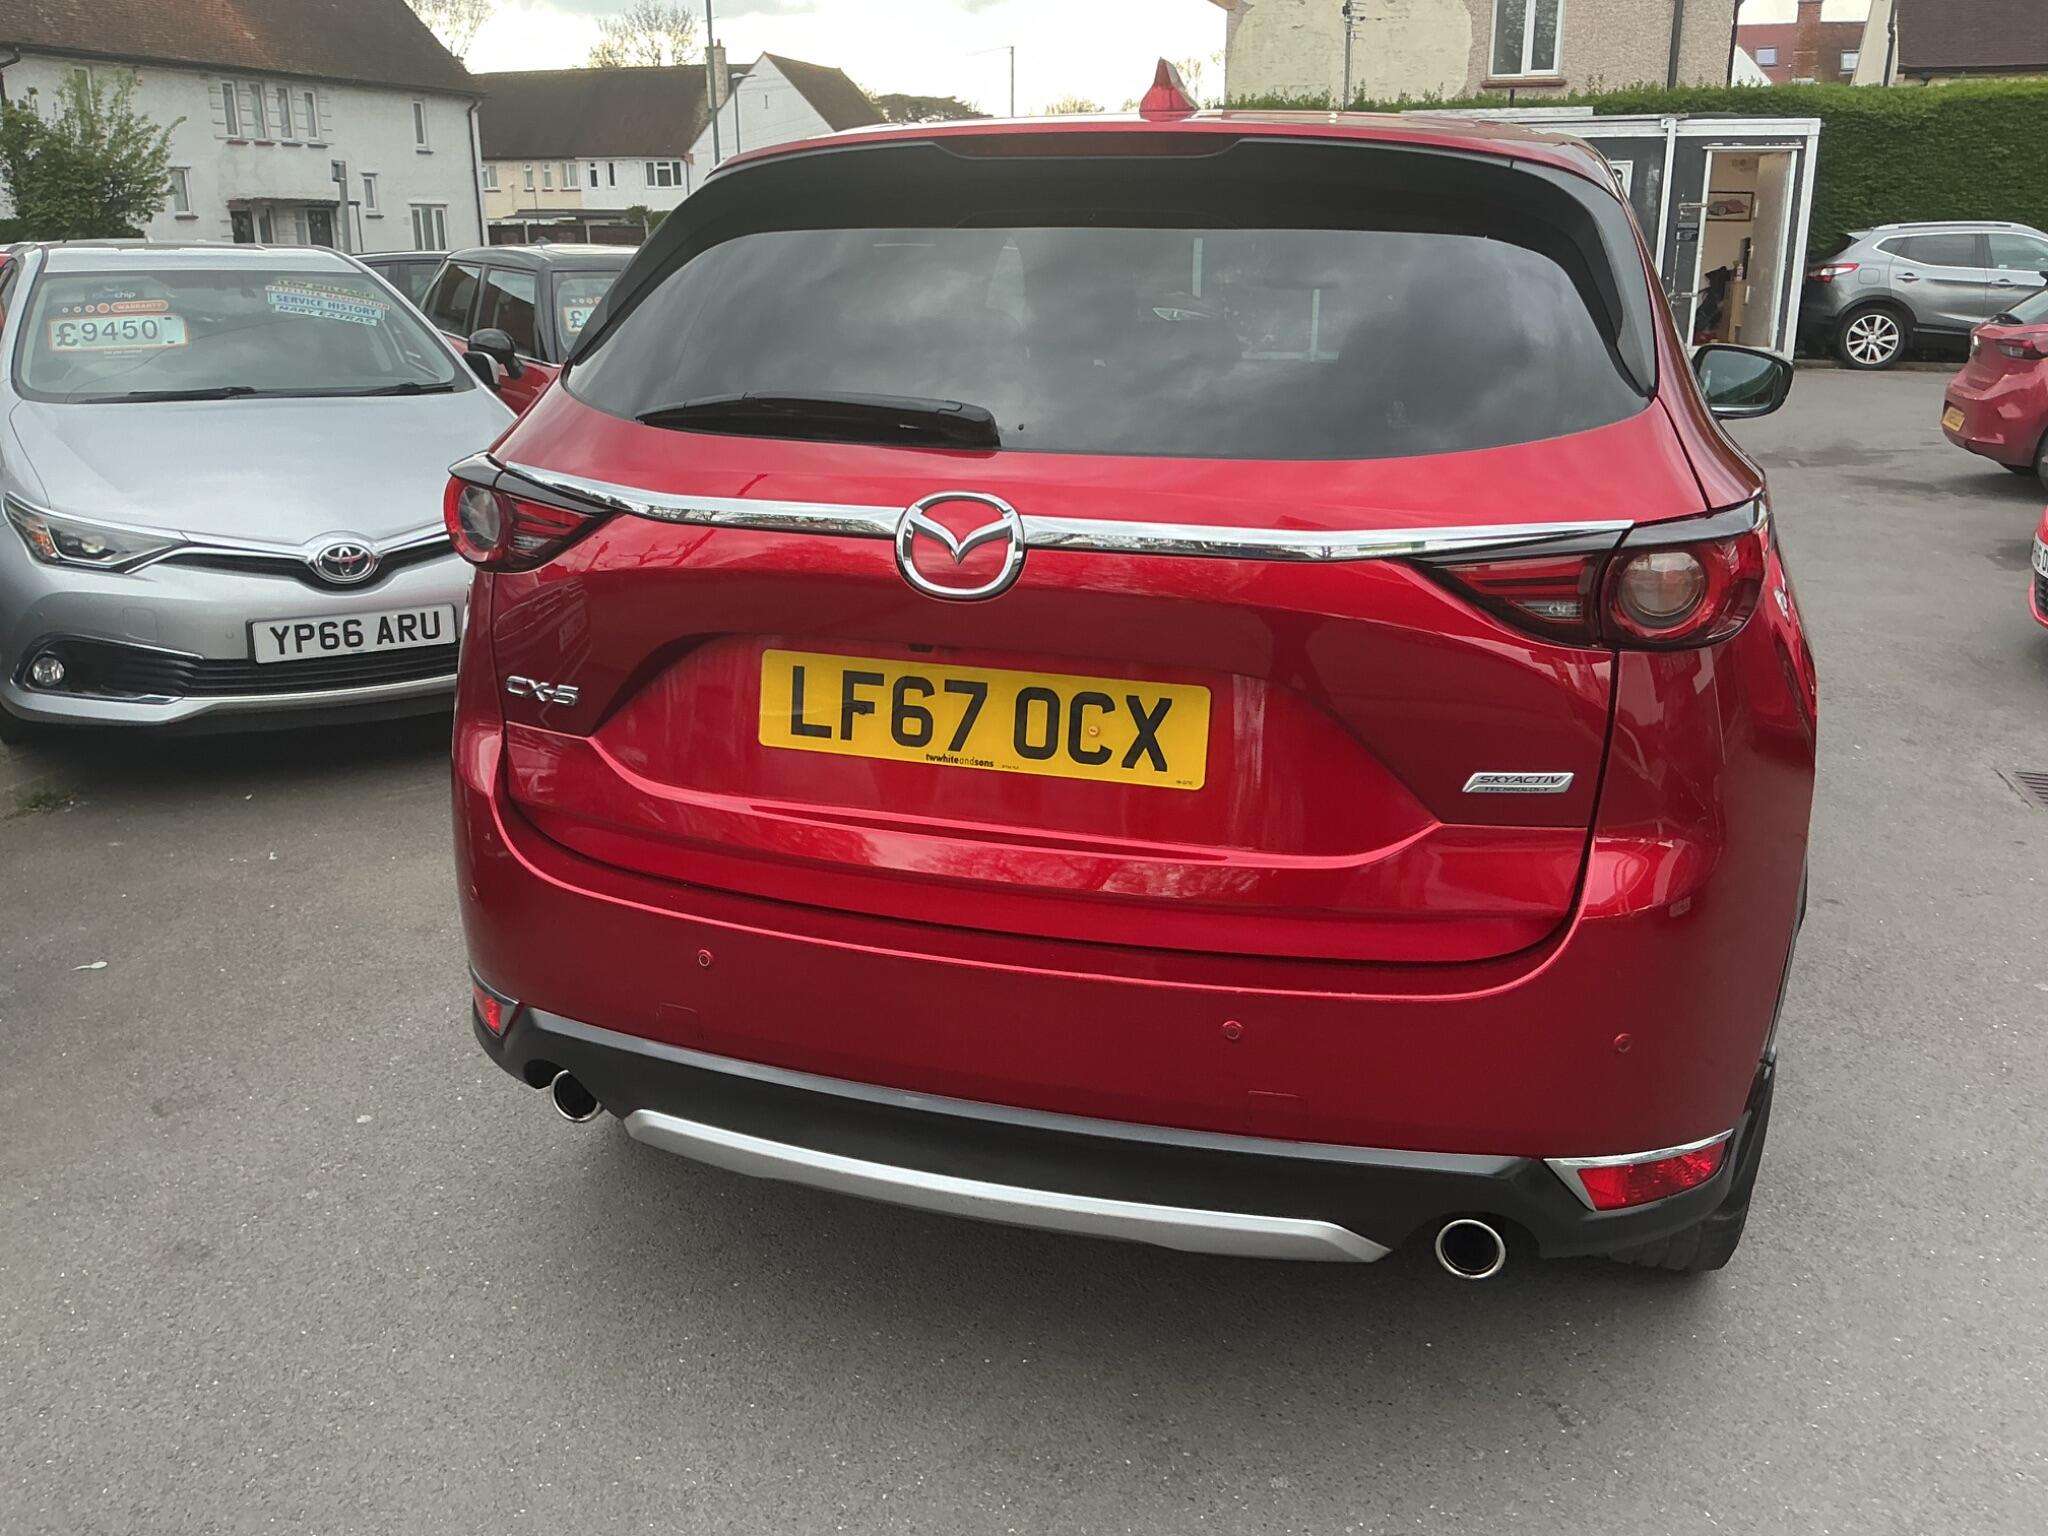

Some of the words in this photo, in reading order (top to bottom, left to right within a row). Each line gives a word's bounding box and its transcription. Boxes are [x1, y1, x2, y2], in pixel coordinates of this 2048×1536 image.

[117, 302, 162, 310] WARRANTY
[276, 294, 321, 306] SERVICE
[328, 302, 377, 316] HISTORY
[56, 320, 159, 347] £9450
[269, 619, 364, 655] YP66
[376, 611, 441, 645] ARU
[506, 675, 579, 705] CX-5
[790, 665, 989, 752] LF67
[1012, 686, 1174, 772] OCX
[1479, 775, 1563, 784] SKYACTIV
